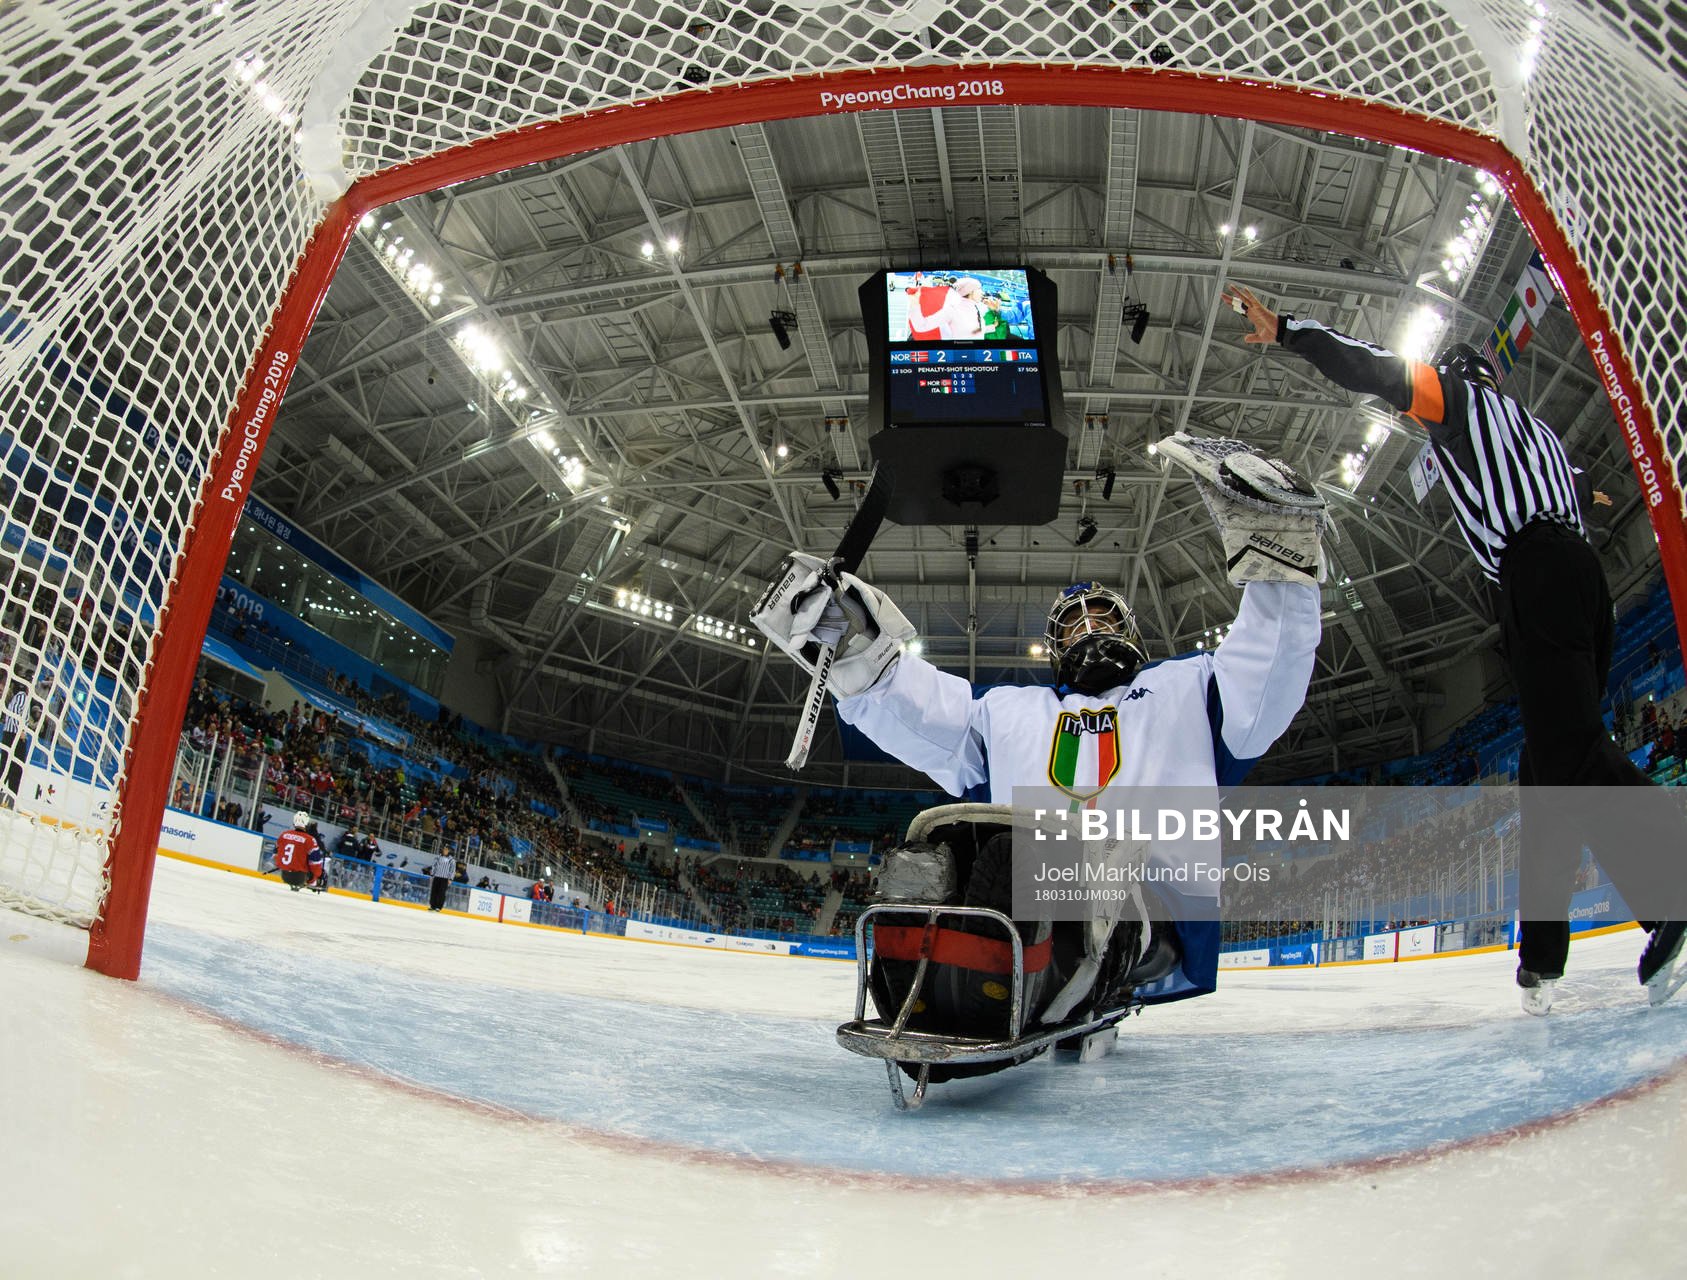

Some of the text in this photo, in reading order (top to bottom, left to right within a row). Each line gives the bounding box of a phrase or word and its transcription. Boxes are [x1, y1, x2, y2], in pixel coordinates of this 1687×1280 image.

[820, 80, 1005, 109] PyeongChang 2018
[936, 350, 946, 363] 2
[982, 350, 993, 362] 2
[1018, 352, 1033, 360] ITA
[220, 350, 289, 502] PyeongChang 2018
[1590, 330, 1663, 508] PyeongChang 2018
[808, 647, 834, 724] FRONTIER
[1064, 713, 1114, 736] ITALIA
[161, 825, 196, 840] nasonic
[281, 844, 295, 865] 3
[1568, 901, 1610, 922] gChang 2018
